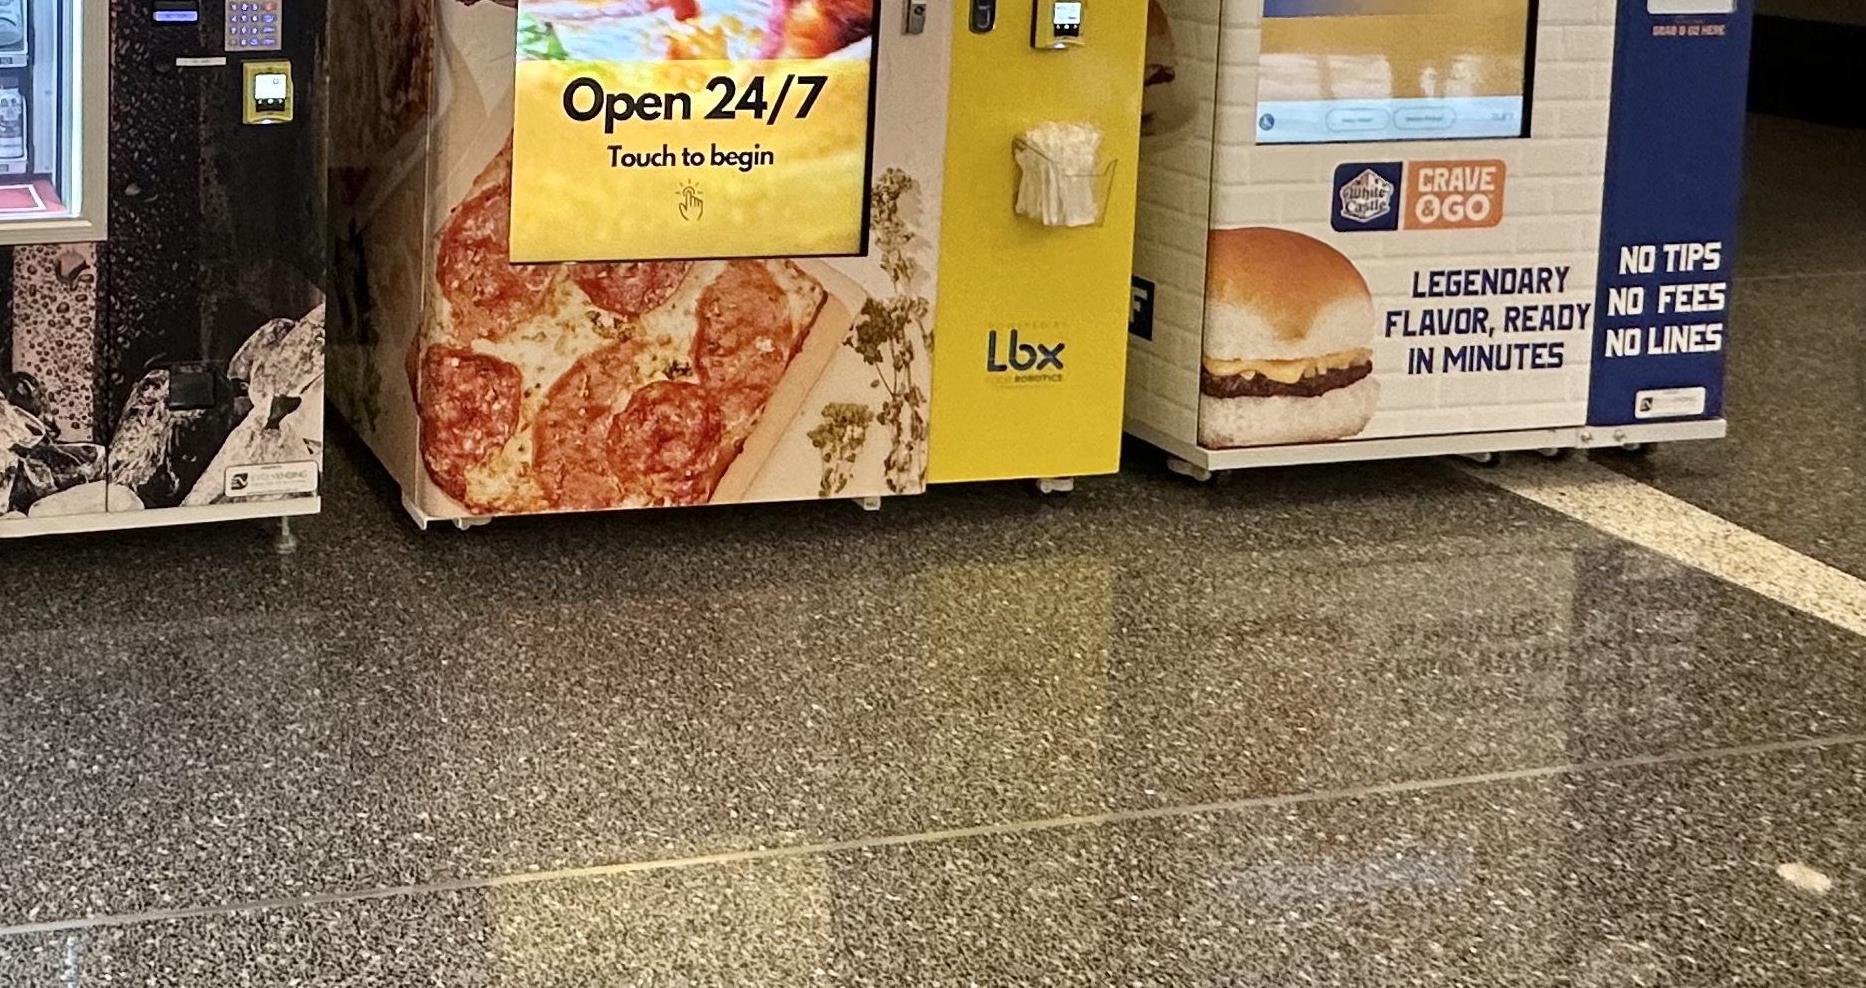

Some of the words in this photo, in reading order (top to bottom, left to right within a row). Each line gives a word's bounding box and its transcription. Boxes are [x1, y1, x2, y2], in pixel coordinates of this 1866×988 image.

[563, 77, 692, 134] Open
[704, 74, 828, 125] 24/7
[607, 144, 676, 168] Touch
[682, 149, 704, 167] to
[711, 143, 774, 172] begin
[1350, 187, 1386, 200] White
[1418, 166, 1496, 192] CRAVE
[1346, 200, 1388, 213] Castle
[1415, 194, 1490, 223] &GO
[1619, 245, 1655, 275] NO
[1663, 242, 1722, 272] TIPS
[1412, 266, 1570, 298] LEGENDARY
[1607, 286, 1644, 317] NO
[1658, 283, 1726, 314] FEES
[1385, 307, 1495, 338] FLAVOR,
[1503, 303, 1592, 333] READY
[987, 329, 1065, 371] Lbx
[1604, 327, 1640, 358] NO
[1647, 324, 1723, 355] LINES
[1408, 346, 1434, 375] IN
[1442, 342, 1565, 373] MINUTES
[1015, 374, 1062, 382] ROBOTICS
